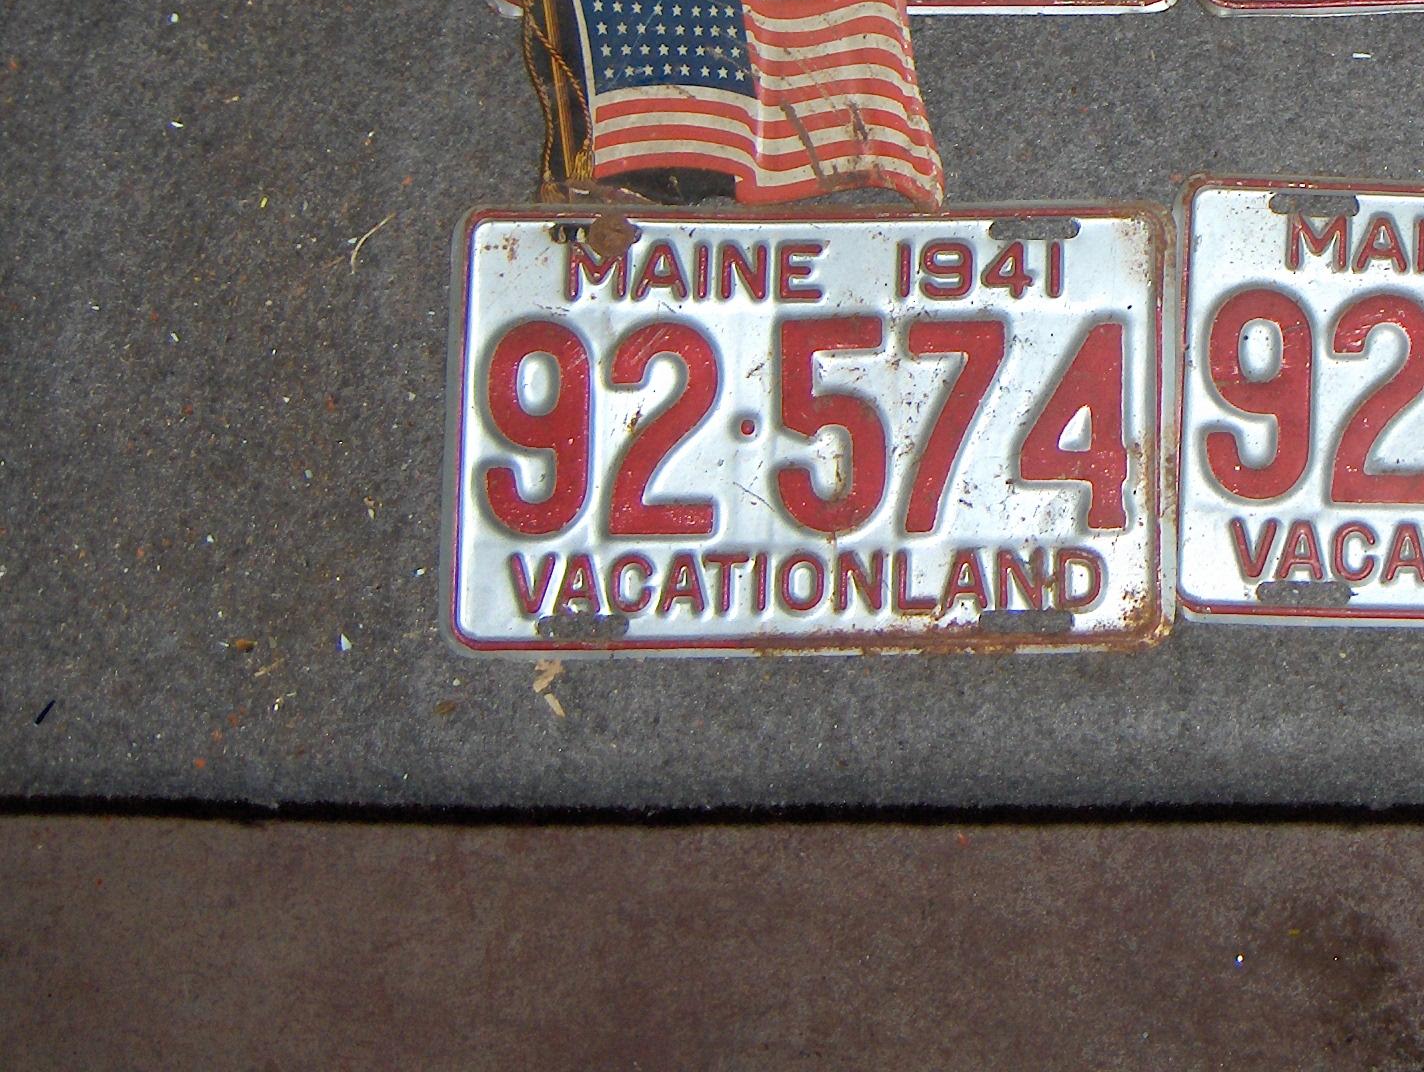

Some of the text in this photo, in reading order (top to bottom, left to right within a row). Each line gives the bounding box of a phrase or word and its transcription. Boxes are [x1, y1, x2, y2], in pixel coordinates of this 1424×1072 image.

[566, 240, 1062, 303] MAINE 1941
[511, 549, 1103, 614] VACATIONLAND
